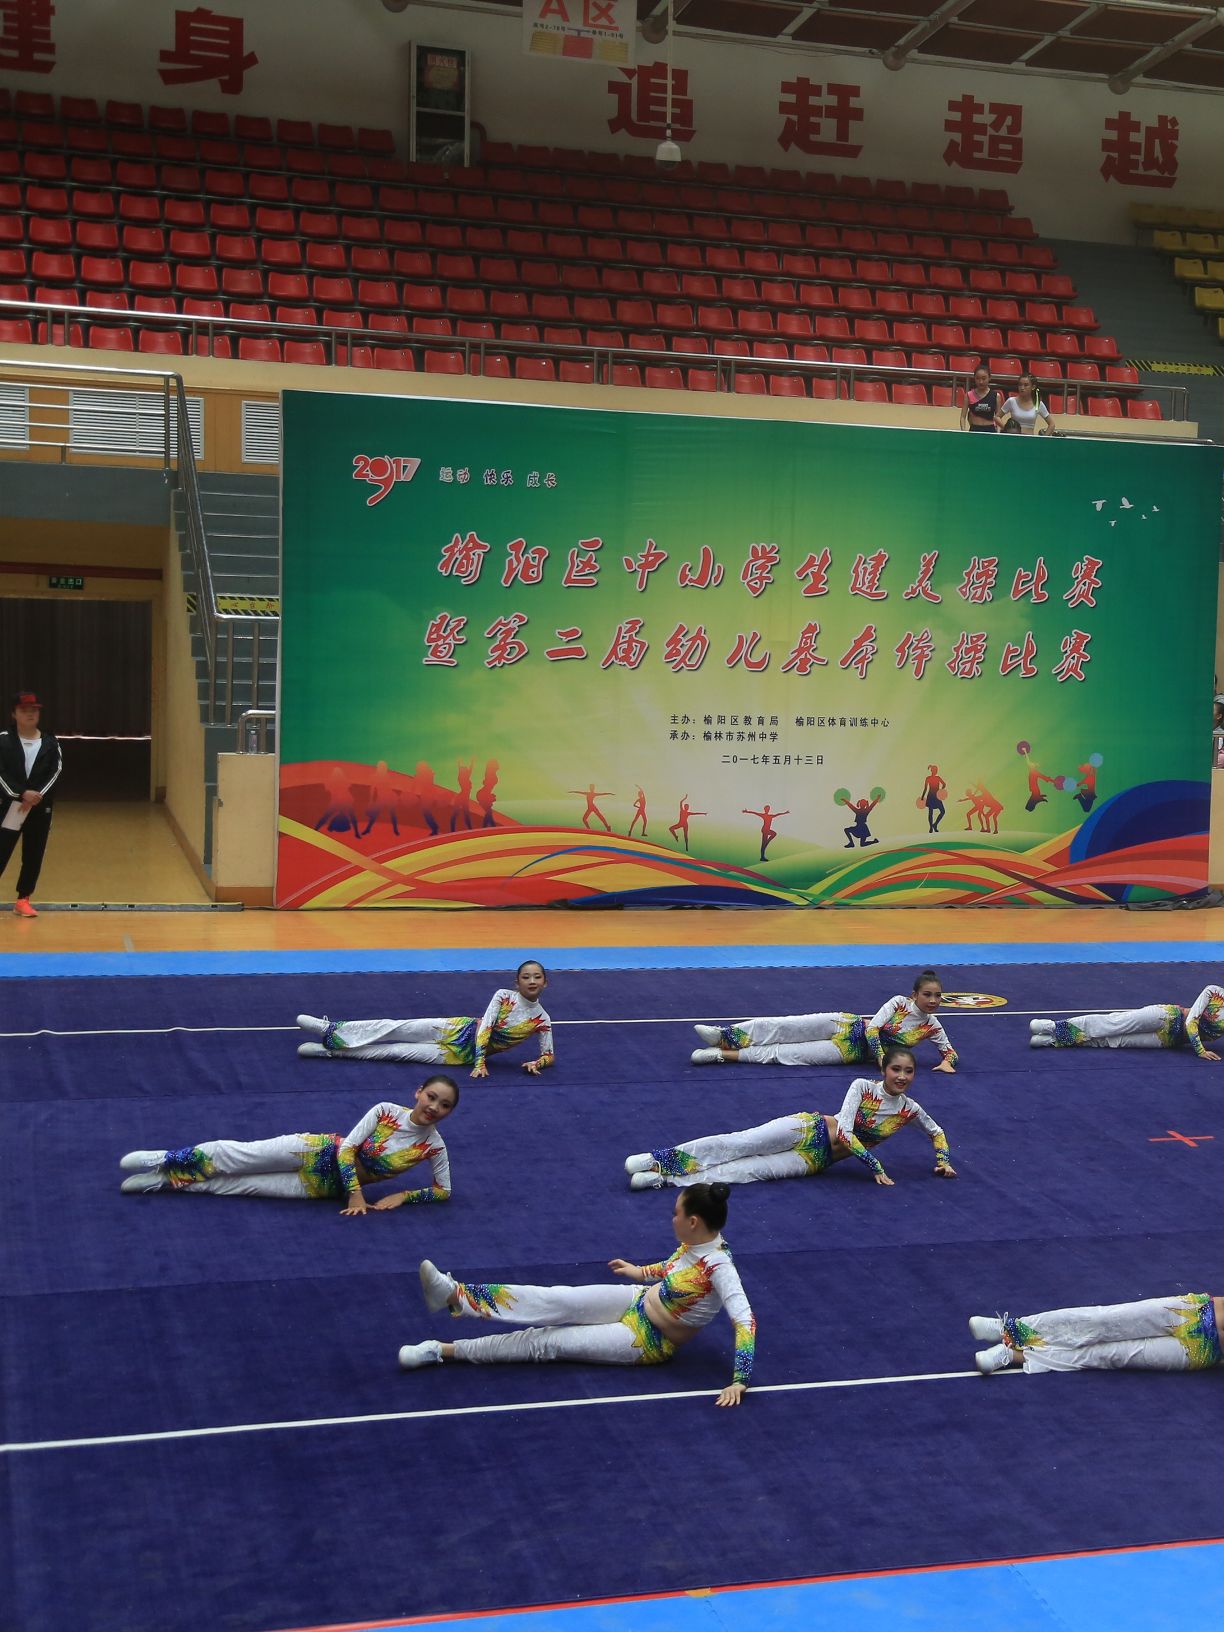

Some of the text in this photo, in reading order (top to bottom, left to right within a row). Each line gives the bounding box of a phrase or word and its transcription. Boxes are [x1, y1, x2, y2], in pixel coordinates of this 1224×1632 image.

[439, 467, 558, 488] 运动 快乐 成长
[438, 531, 1103, 609] 榆阳区中小学生健美操比赛
[422, 611, 1092, 683] 暨第二届幼儿基本体操比赛
[795, 716, 890, 728] 榆阳区体育训练中心
